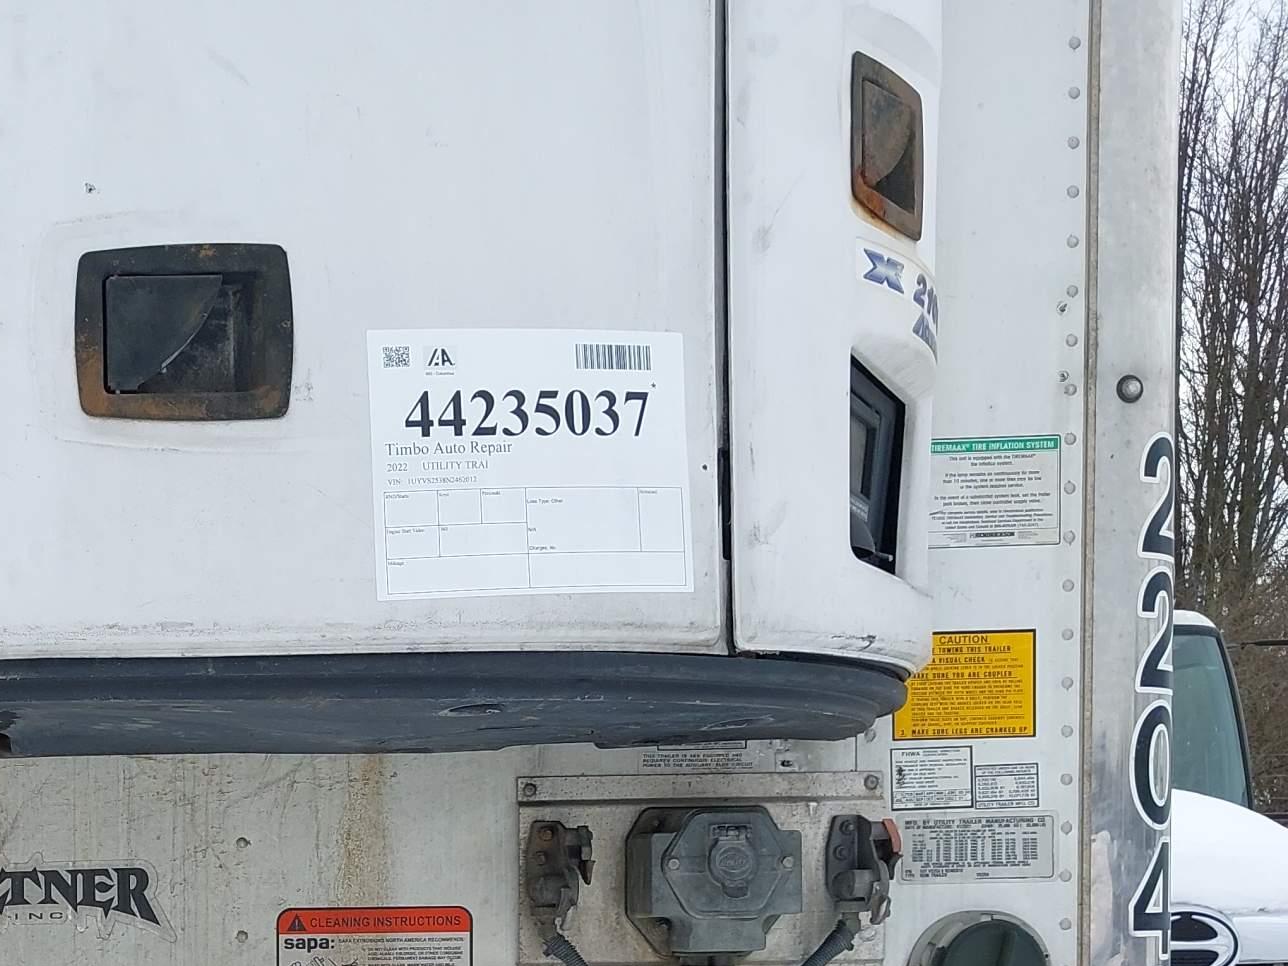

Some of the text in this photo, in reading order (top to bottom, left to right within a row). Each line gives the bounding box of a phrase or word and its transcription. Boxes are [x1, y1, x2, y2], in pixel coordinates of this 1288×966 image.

[405, 390, 649, 437] 44235037
[385, 441, 512, 456] Timbo Auto Repair
[989, 442, 1024, 450] INFLATION
[1027, 440, 1054, 448] SYSTEM
[387, 461, 488, 472] 2022 UTILITY TRAI
[939, 635, 988, 644] CAUTION
[16, 912, 64, 920] INC
[310, 915, 461, 928] CLEANING INSTRUCTIONS
